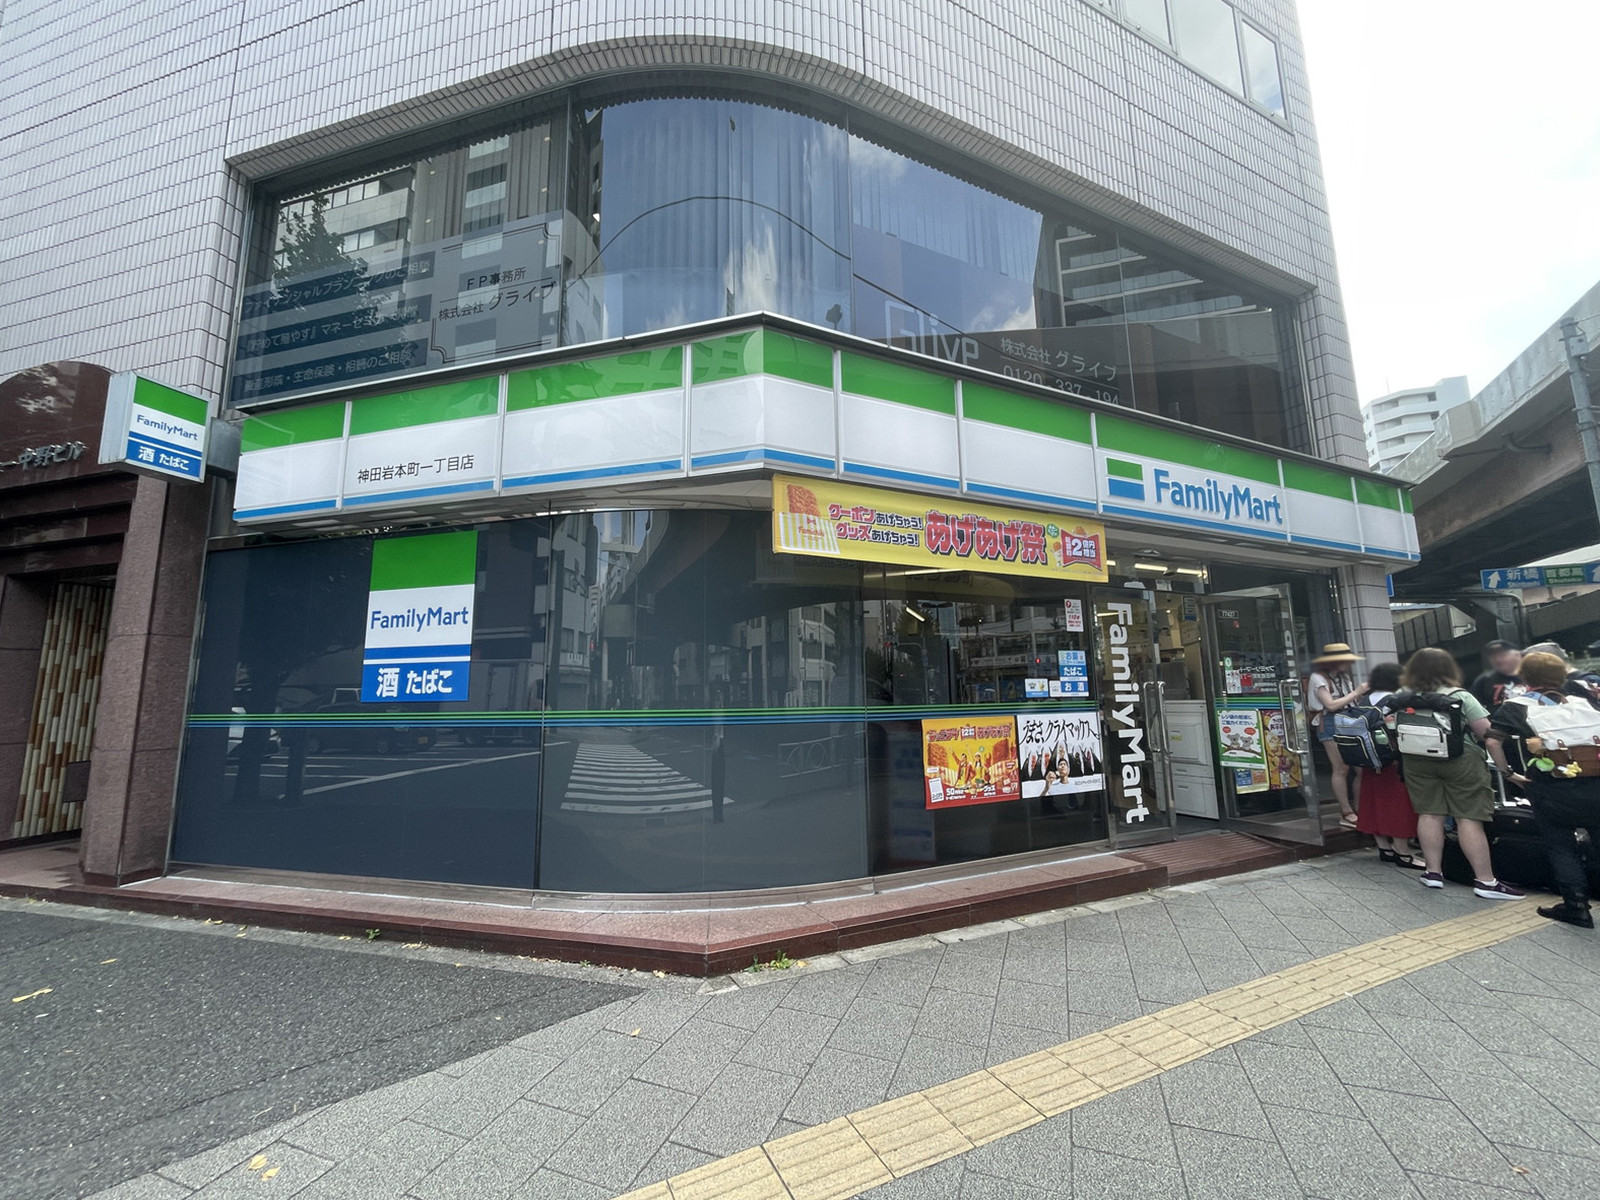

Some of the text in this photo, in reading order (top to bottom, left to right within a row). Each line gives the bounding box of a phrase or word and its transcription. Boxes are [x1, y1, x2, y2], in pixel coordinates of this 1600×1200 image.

[438, 301, 484, 321] 株式会社
[1000, 337, 1052, 365] 株式会社
[137, 414, 198, 441] FamilyMart
[138, 446, 190, 471] 酒 たばこ
[357, 454, 475, 484] 神田岩本町一丁目店
[1153, 468, 1283, 525] FamilyMart
[828, 503, 923, 528] クーポンあげちゃう!
[835, 522, 919, 547] グッズあげちゃう!
[925, 510, 1048, 565] あげあげ祭
[1506, 567, 1540, 581] 新橋
[371, 606, 469, 632] FamilyMart
[376, 667, 453, 698] 酒 たばこ
[1063, 666, 1083, 676] たばこ
[1106, 602, 1151, 825] FamilyMart
